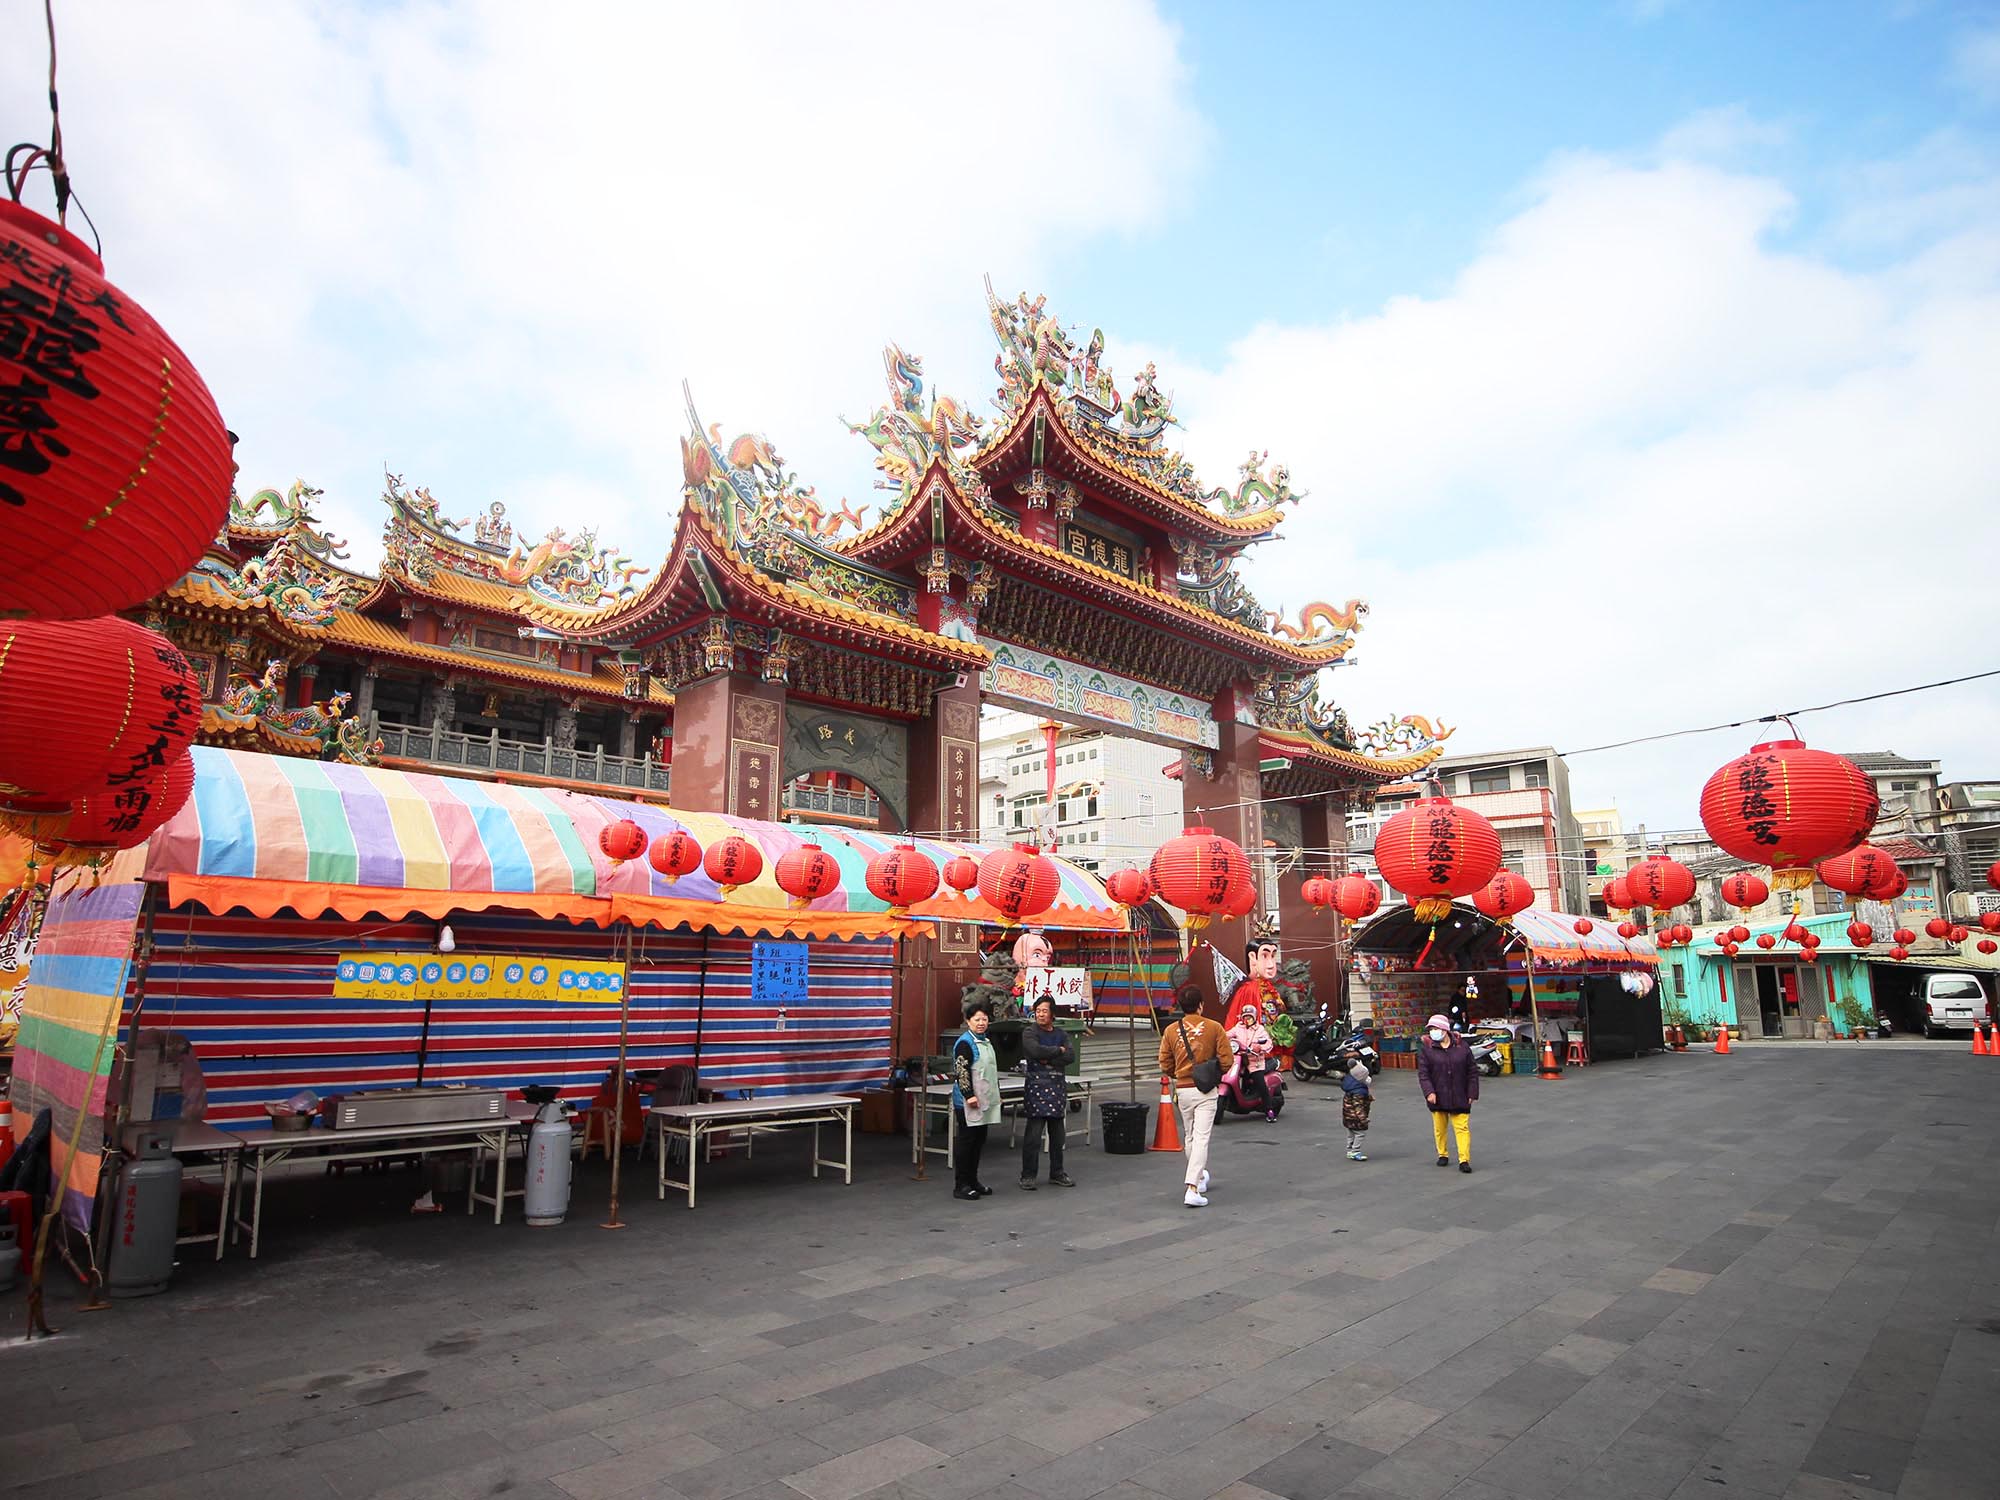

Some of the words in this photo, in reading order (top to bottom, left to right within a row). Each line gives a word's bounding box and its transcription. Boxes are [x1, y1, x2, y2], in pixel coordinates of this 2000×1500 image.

[0, 280, 101, 507] 龍德
[1739, 766, 1781, 846] 龍德宮
[807, 854, 826, 893] 風調雨順
[882, 853, 902, 897] 風調雨順
[1206, 840, 1229, 905] 風調雨順
[1424, 816, 1456, 885] 龍德宮
[1003, 863, 1031, 914] 風調雨順
